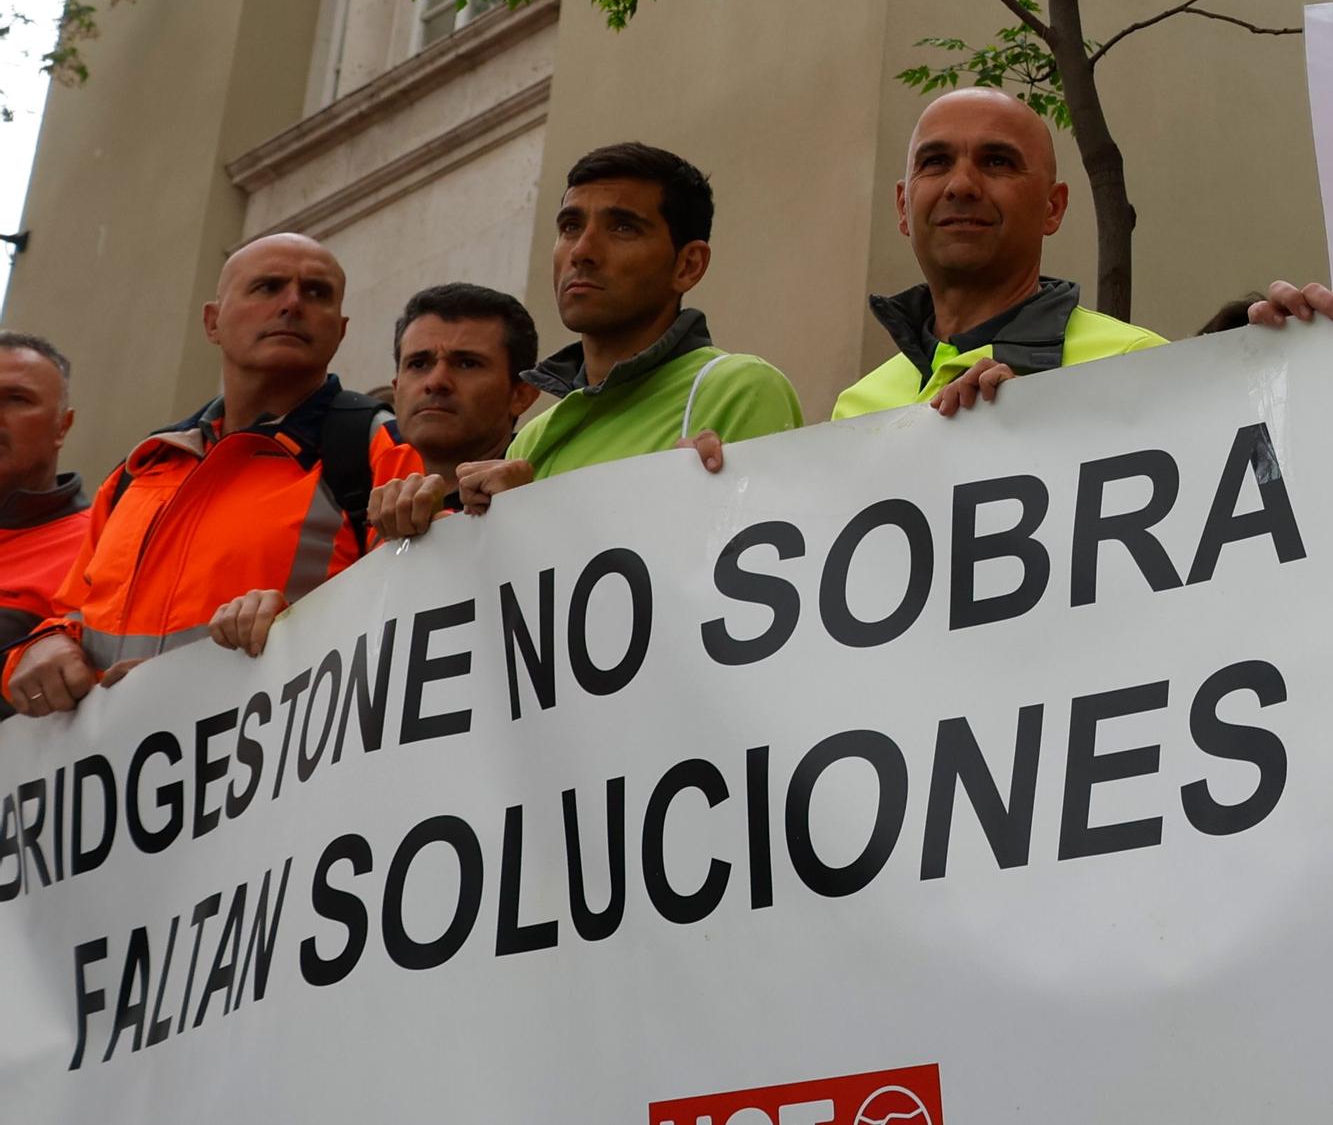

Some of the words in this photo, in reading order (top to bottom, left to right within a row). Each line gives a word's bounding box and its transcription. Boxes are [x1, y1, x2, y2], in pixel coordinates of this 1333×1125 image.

[0, 598, 476, 903] BRIDGESTONE
[500, 547, 653, 722] NO
[700, 422, 1307, 666] SOBRA
[68, 857, 293, 1072] FALTAN
[299, 660, 1288, 987] SOLUCIONES
